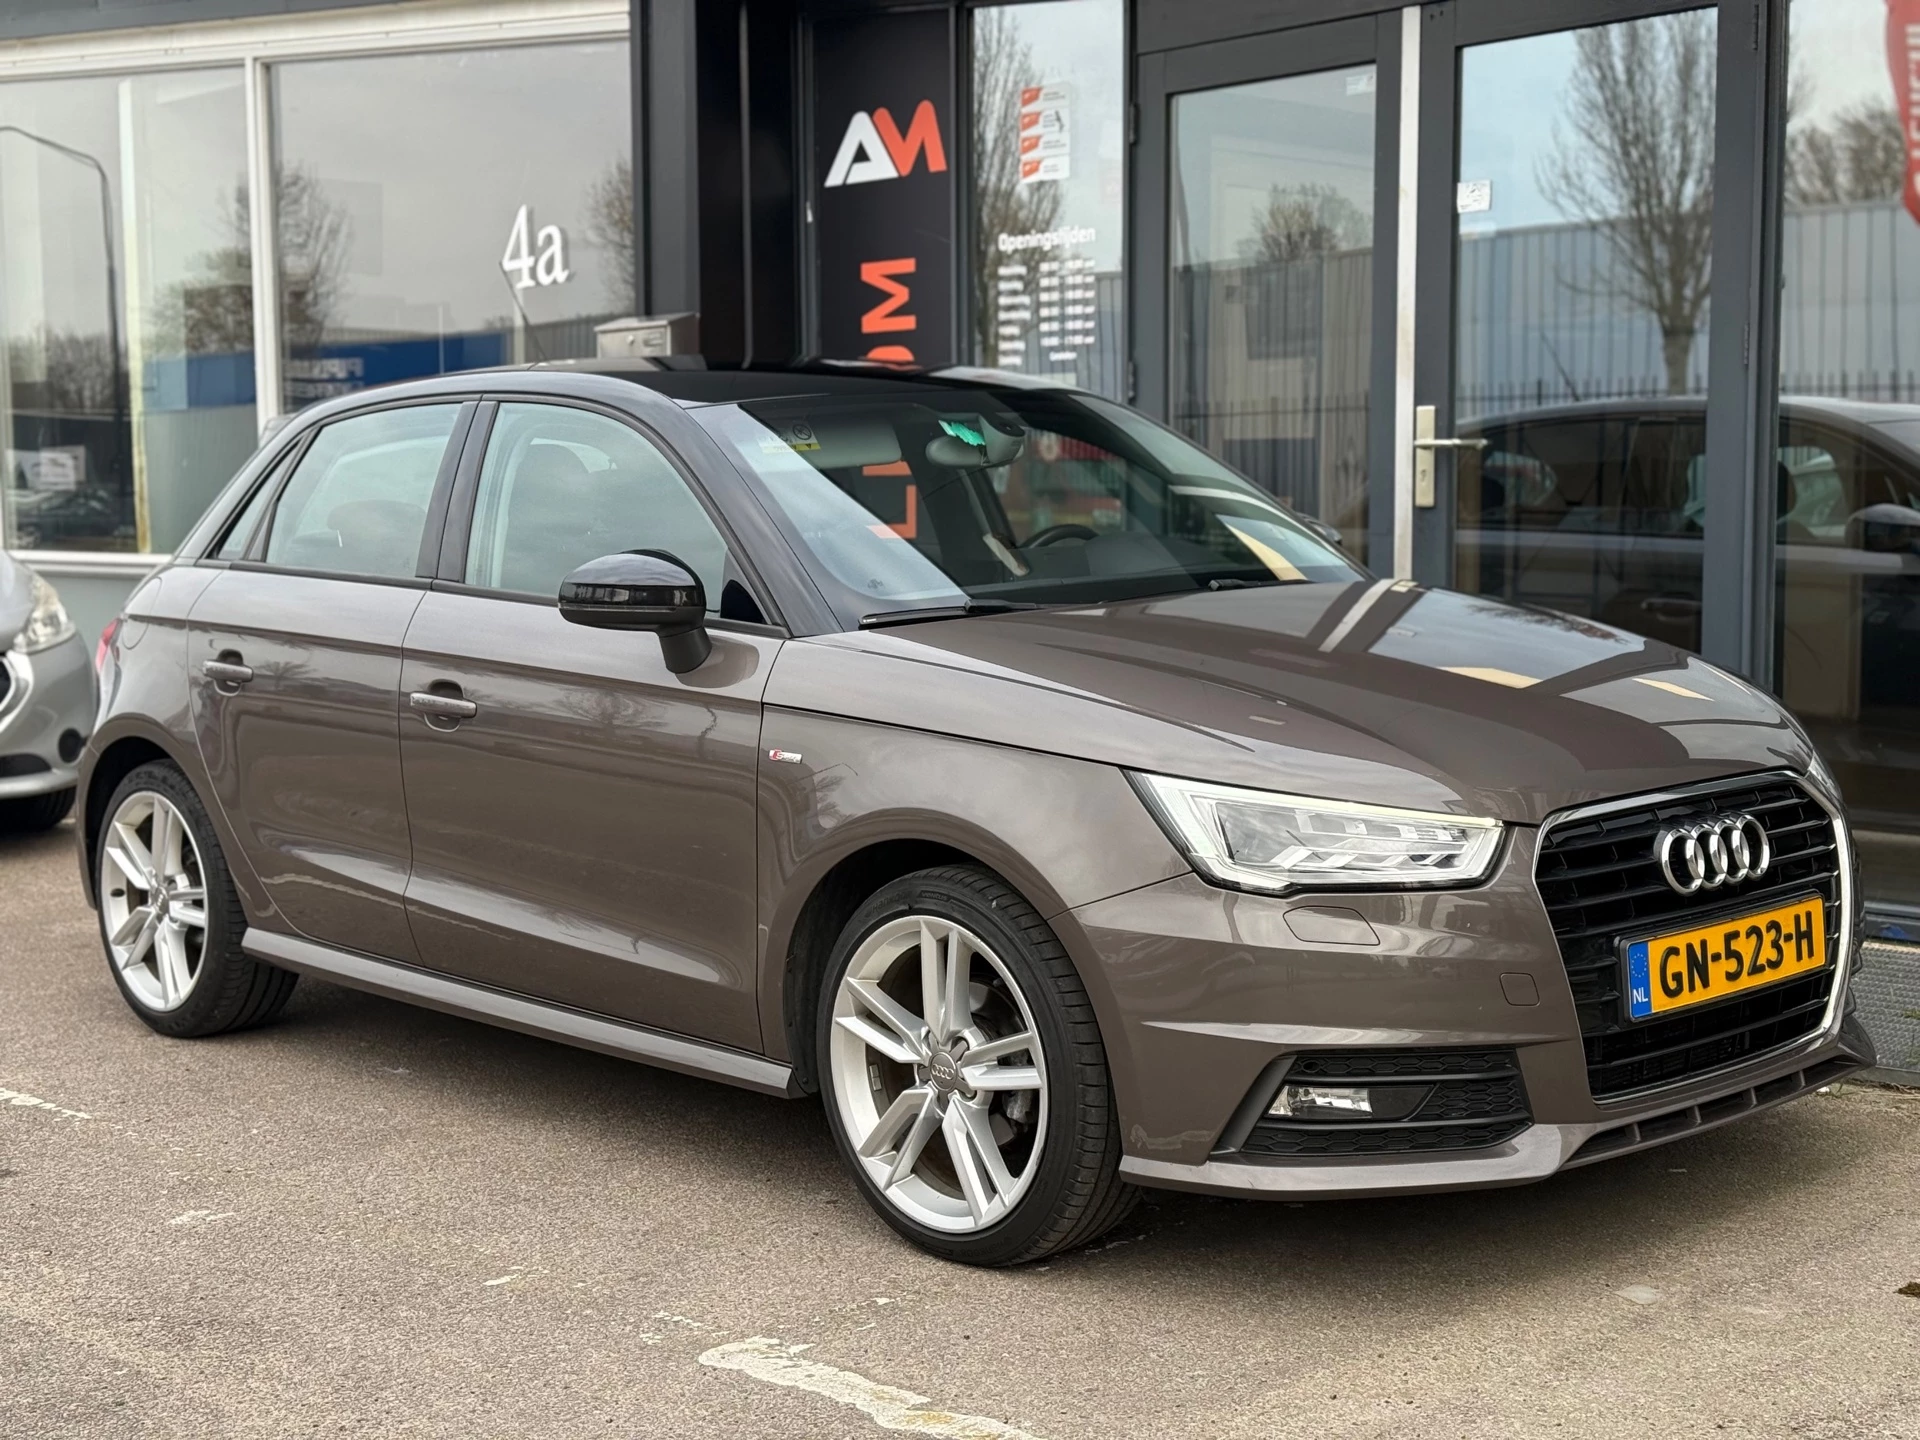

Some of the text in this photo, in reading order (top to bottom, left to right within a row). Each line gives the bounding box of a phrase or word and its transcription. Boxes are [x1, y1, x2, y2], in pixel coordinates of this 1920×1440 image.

[824, 99, 948, 188] AM
[502, 204, 570, 289] 4a
[997, 227, 1096, 254] Openingstijden
[860, 257, 917, 362] M
[1633, 988, 1649, 1005] NL
[1659, 910, 1815, 998] GN-523-H
